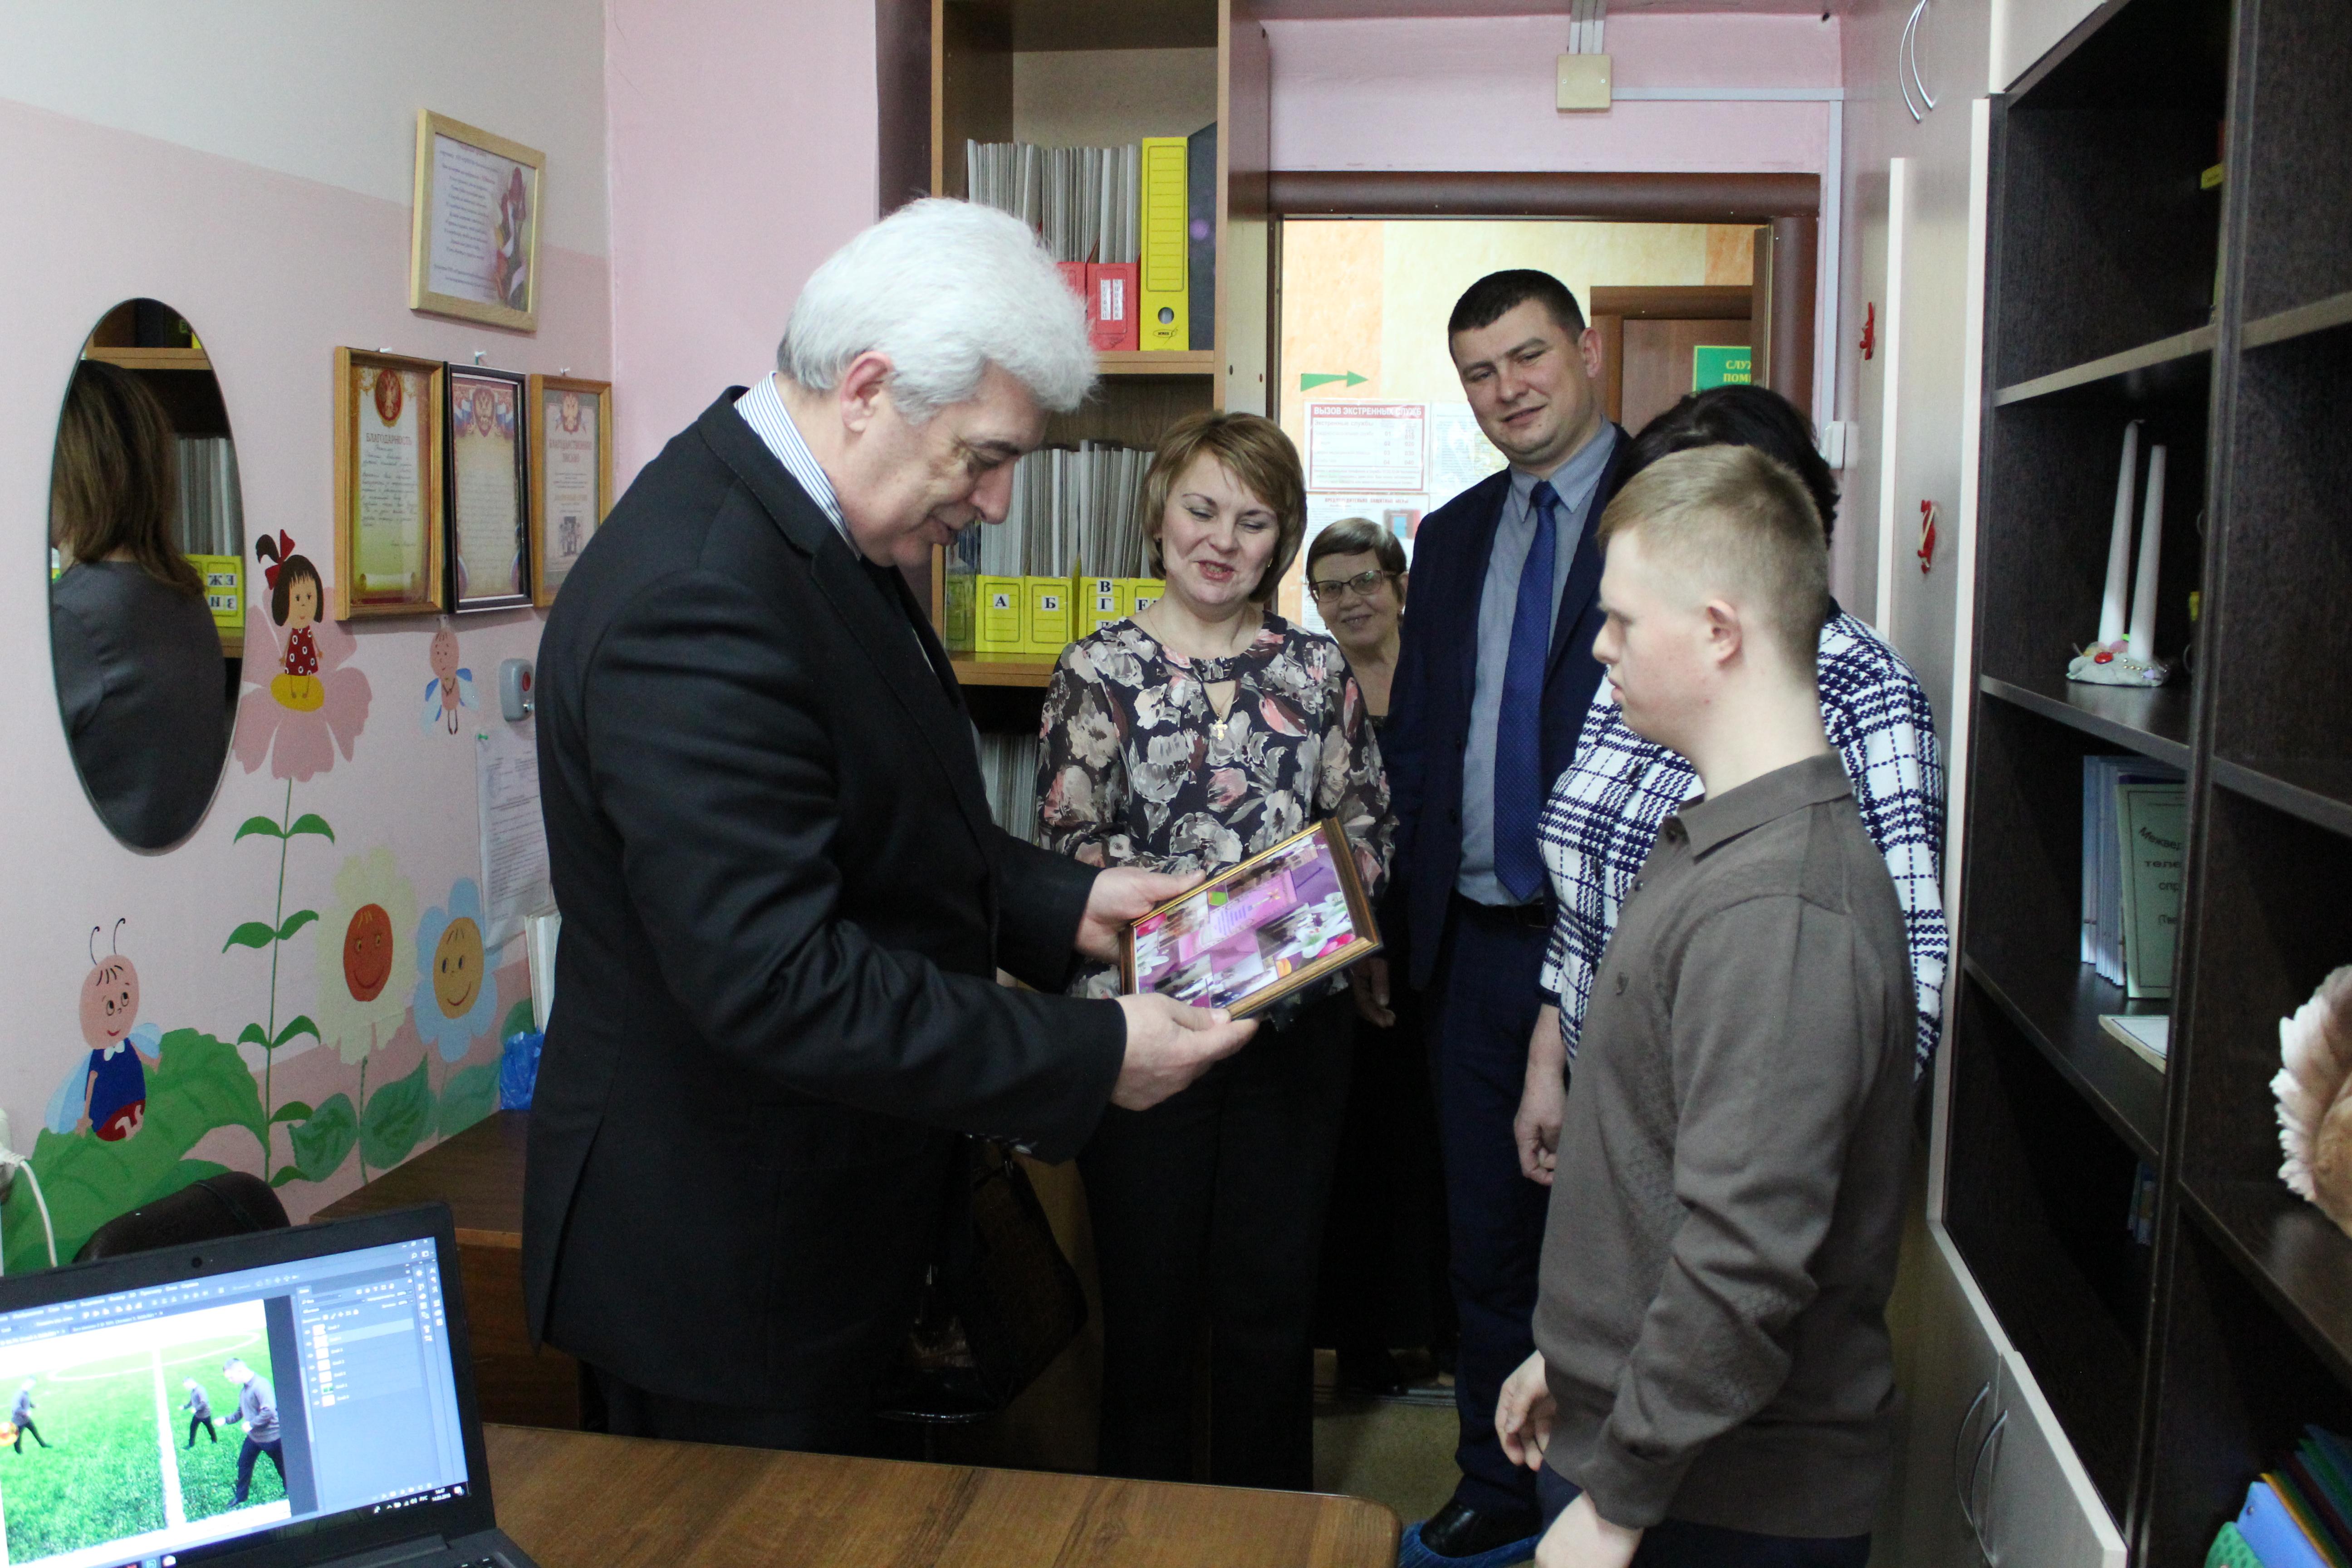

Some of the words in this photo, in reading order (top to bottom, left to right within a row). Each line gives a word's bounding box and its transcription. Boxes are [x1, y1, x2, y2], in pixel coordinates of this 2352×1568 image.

[1723, 374, 1751, 382] ПОМ
[1314, 407, 1341, 415] ВЫЗОВ
[1343, 407, 1393, 416] ЭКСТРЕННЫХ
[1395, 407, 1422, 416] СЛУЖБ
[366, 432, 412, 445] БЛАГОДАРНОСТЬ
[1100, 581, 1111, 593] В
[995, 596, 1007, 607] А
[1045, 597, 1056, 609] Б
[1101, 598, 1111, 610] Г
